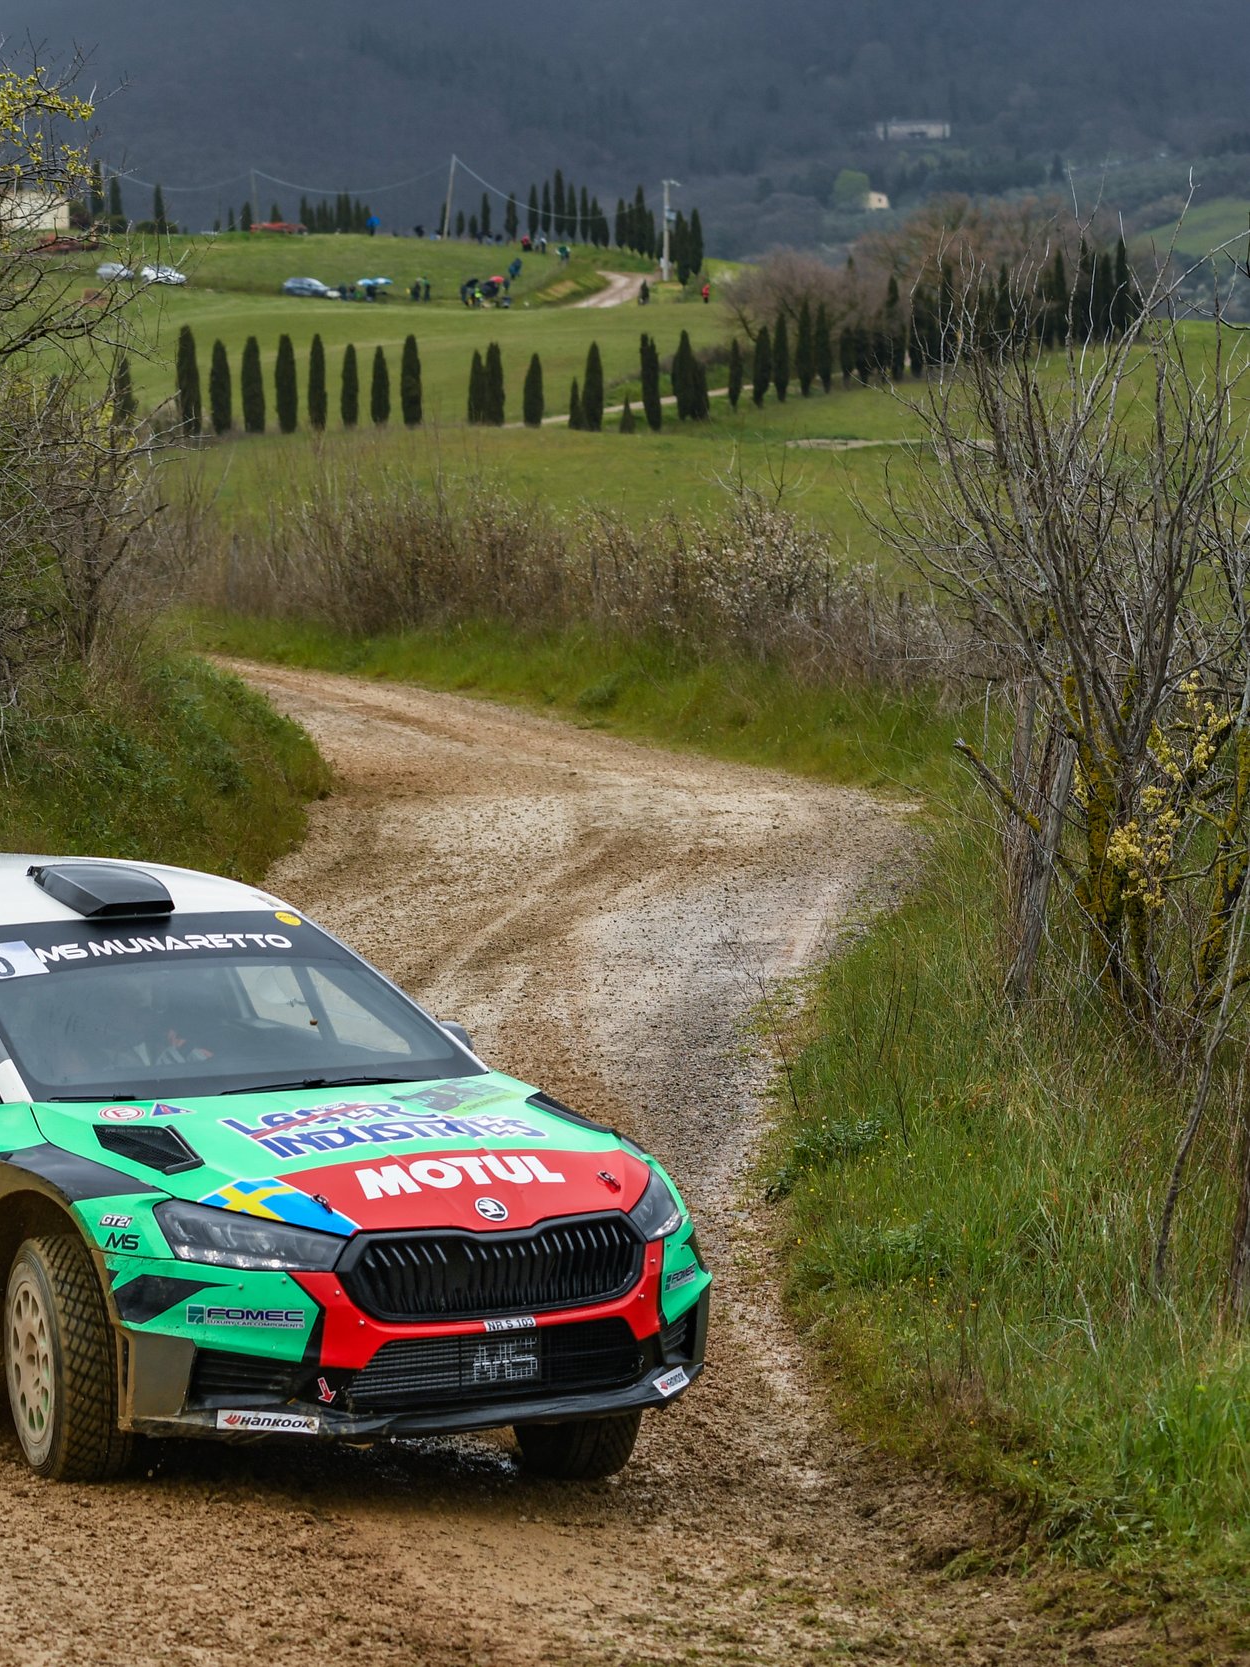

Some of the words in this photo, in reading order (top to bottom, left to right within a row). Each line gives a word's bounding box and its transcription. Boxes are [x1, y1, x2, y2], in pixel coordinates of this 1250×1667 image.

[34, 943, 88, 963] MS
[88, 933, 293, 957] MUNARETTO
[111, 1108, 132, 1118] E
[354, 1155, 566, 1200] MOTUL
[105, 1231, 141, 1251] MS
[207, 1308, 304, 1322] FOMEC
[253, 1321, 305, 1329] COMPONENTS
[488, 1322, 504, 1332] NR
[507, 1320, 513, 1329] S
[517, 1317, 535, 1328] 103
